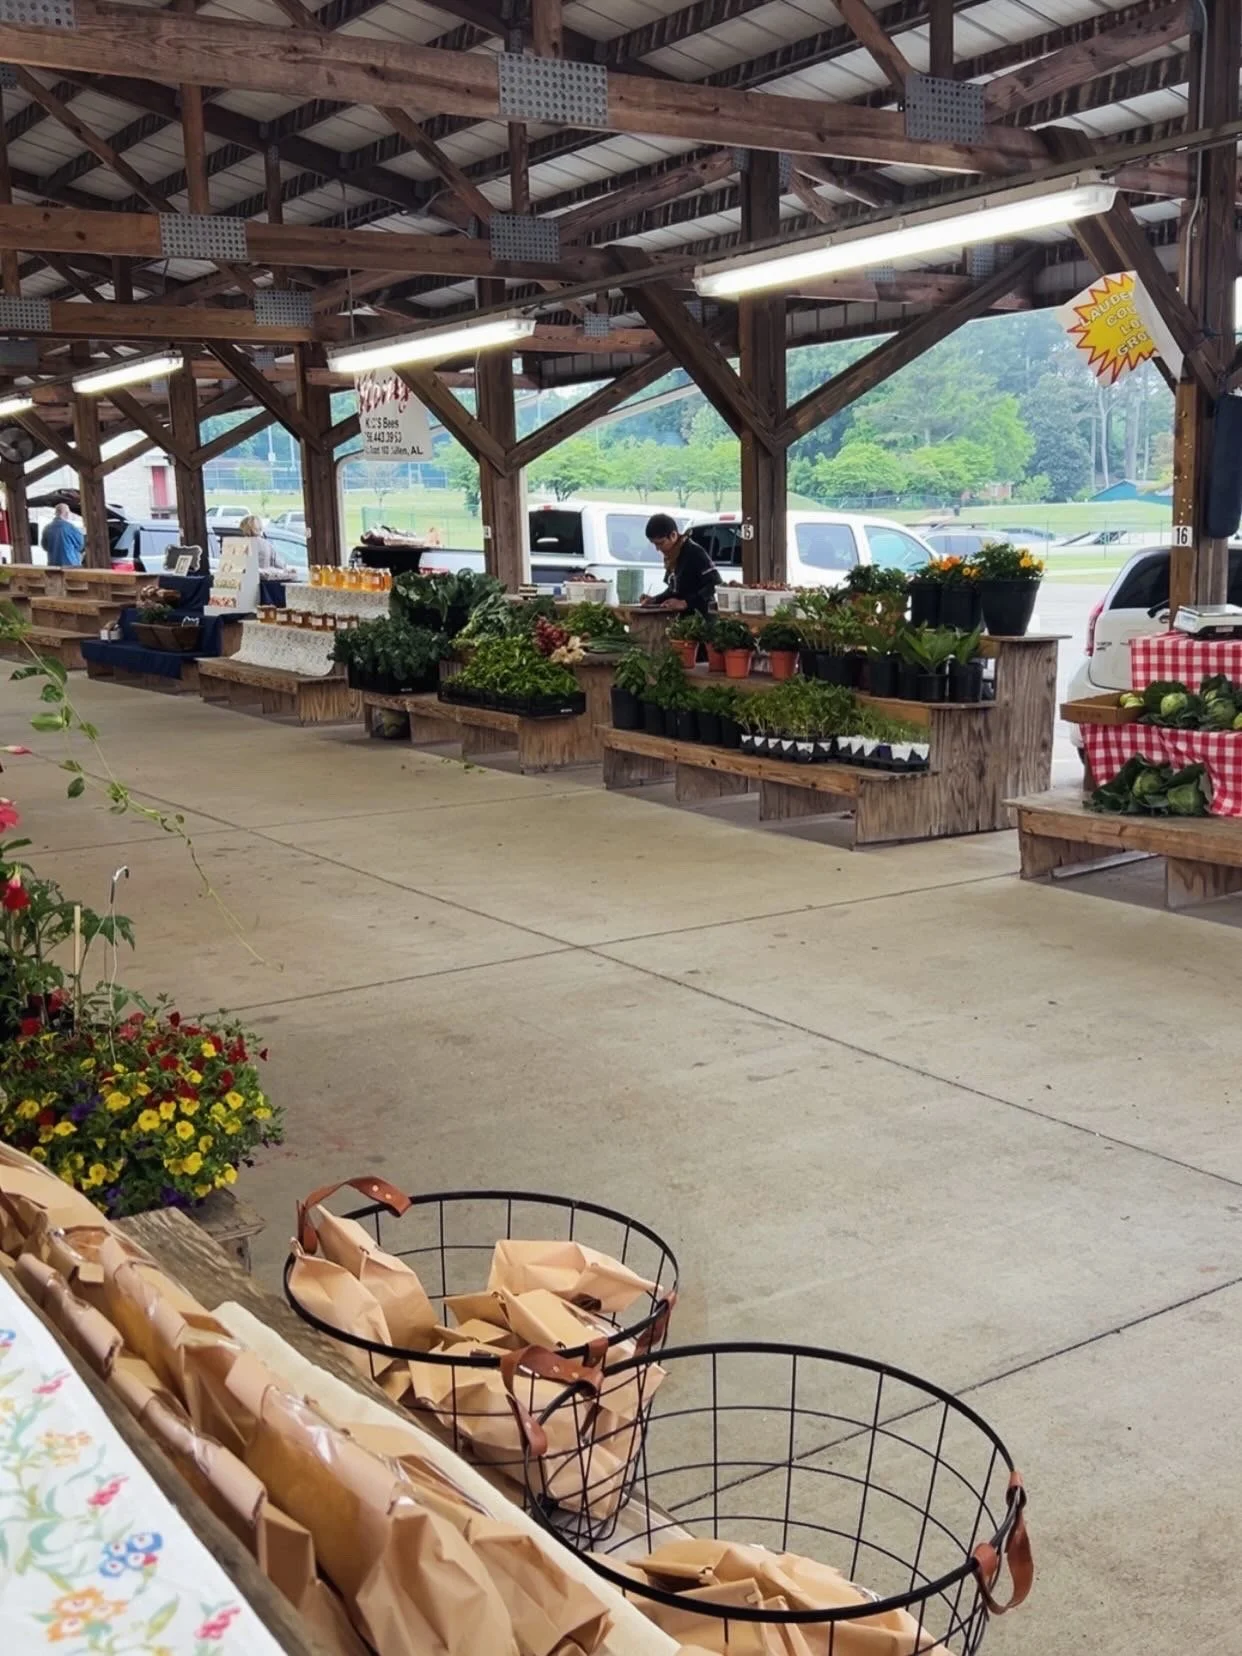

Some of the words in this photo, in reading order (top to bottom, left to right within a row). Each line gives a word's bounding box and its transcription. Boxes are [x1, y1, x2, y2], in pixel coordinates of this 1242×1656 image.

[1120, 318, 1143, 336] LO
[1117, 331, 1150, 356] GRO
[1176, 527, 1188, 545] 16
